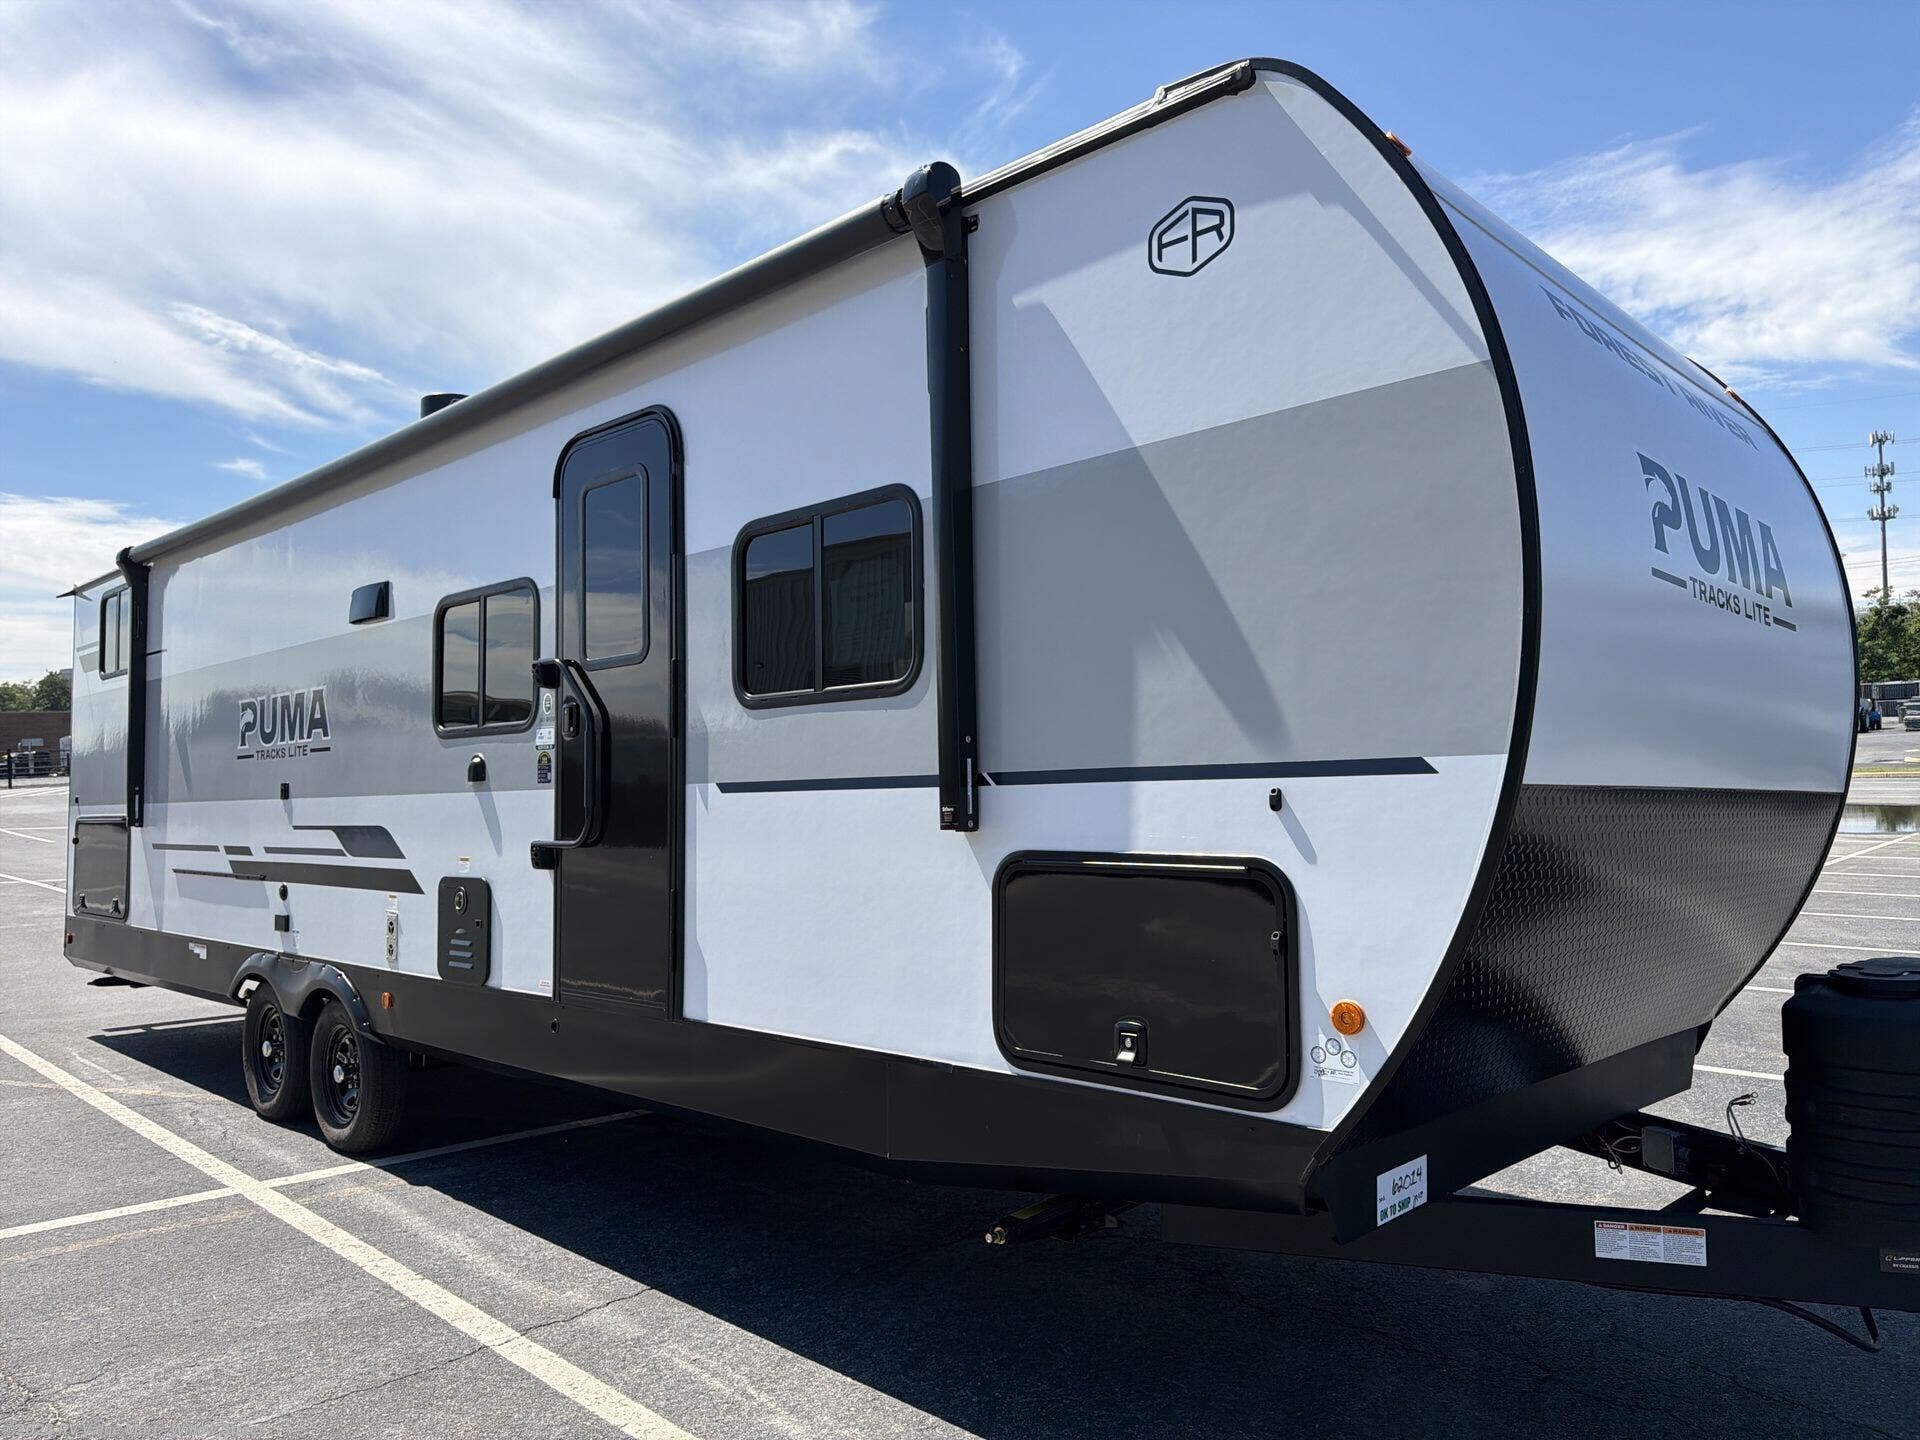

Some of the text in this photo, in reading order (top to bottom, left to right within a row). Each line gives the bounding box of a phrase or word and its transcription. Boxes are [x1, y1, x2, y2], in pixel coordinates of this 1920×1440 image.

[1537, 283, 1761, 452] FOREST RIVER
[1636, 451, 1793, 608] PUMA
[1689, 575, 1772, 627] TRACKS LITE
[239, 686, 331, 748] PUMA
[256, 745, 308, 761] TRACKS LITE
[1390, 1203, 1397, 1217] TO
[1398, 1196, 1411, 1213] SHIP
